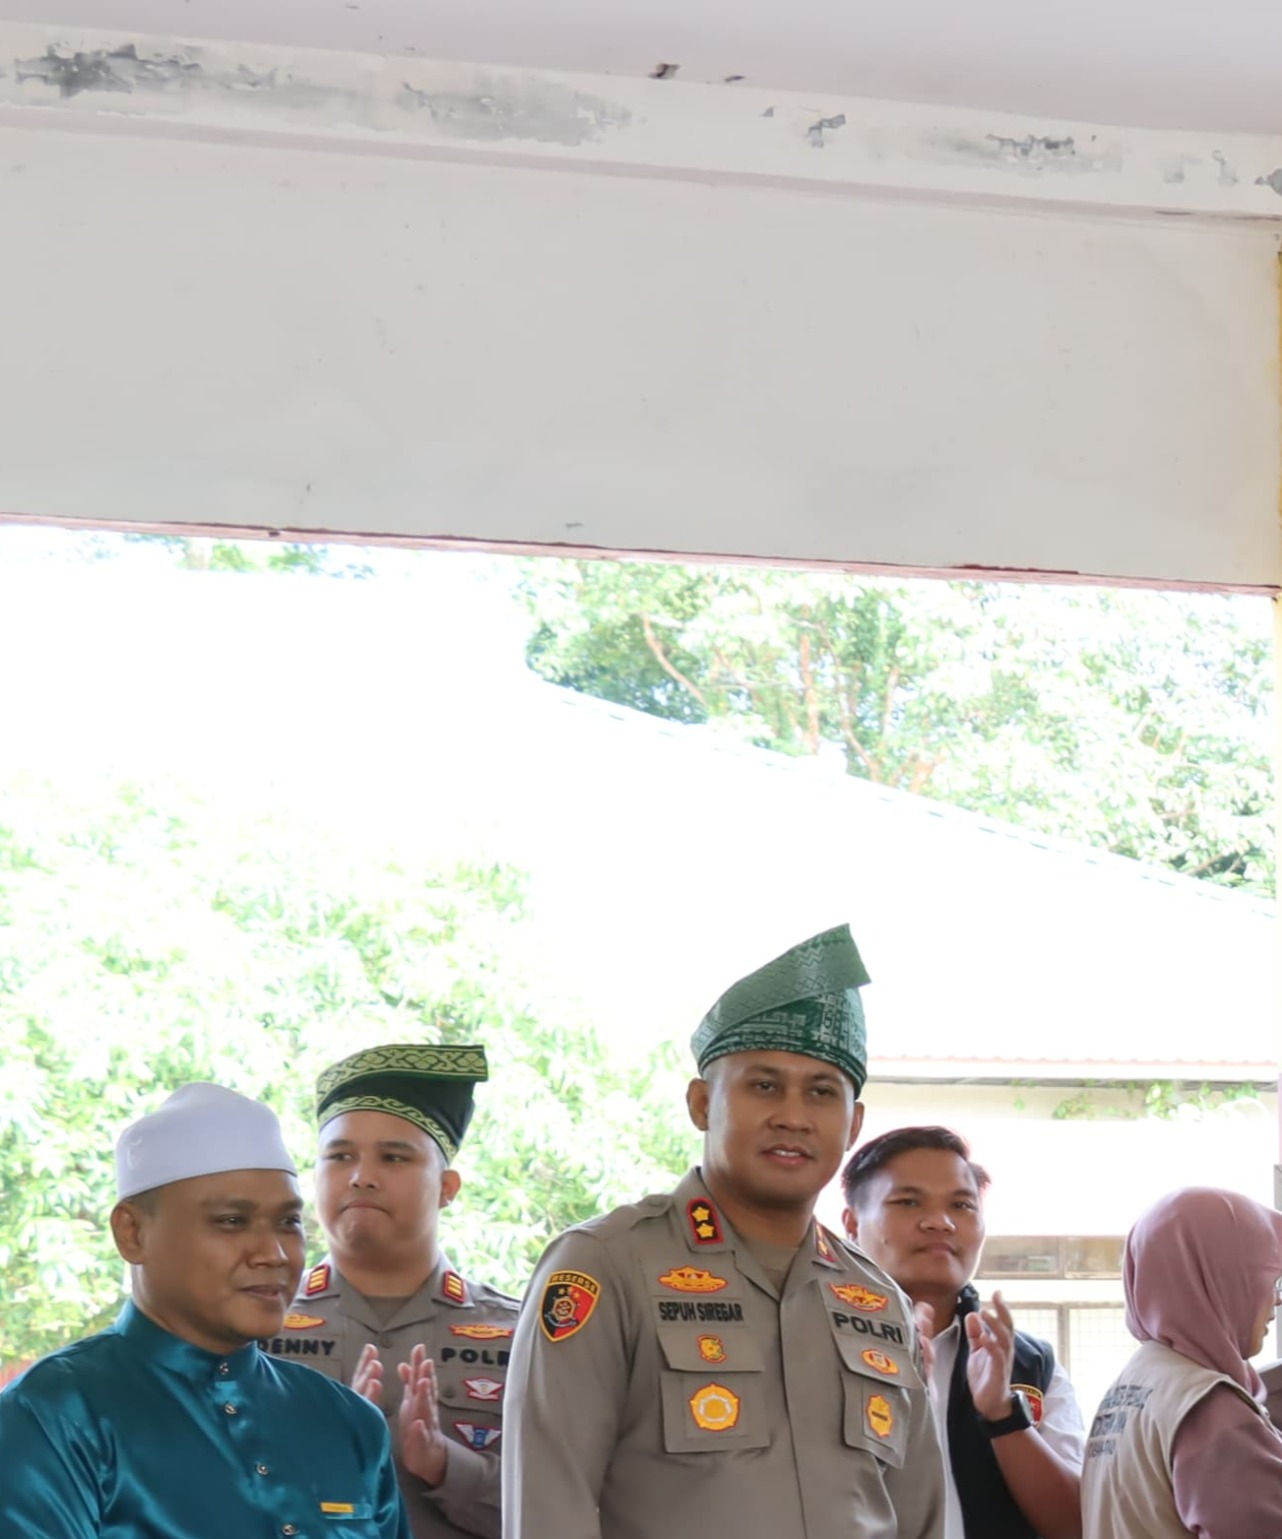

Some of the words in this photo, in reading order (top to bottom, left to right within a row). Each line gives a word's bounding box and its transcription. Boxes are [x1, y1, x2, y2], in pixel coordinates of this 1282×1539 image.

[551, 1274, 597, 1293] RESERSE
[658, 1301, 697, 1321] SEPUH
[697, 1302, 744, 1322] SIREGAR
[832, 1311, 904, 1345] POLRI
[257, 1338, 335, 1356] DENNY
